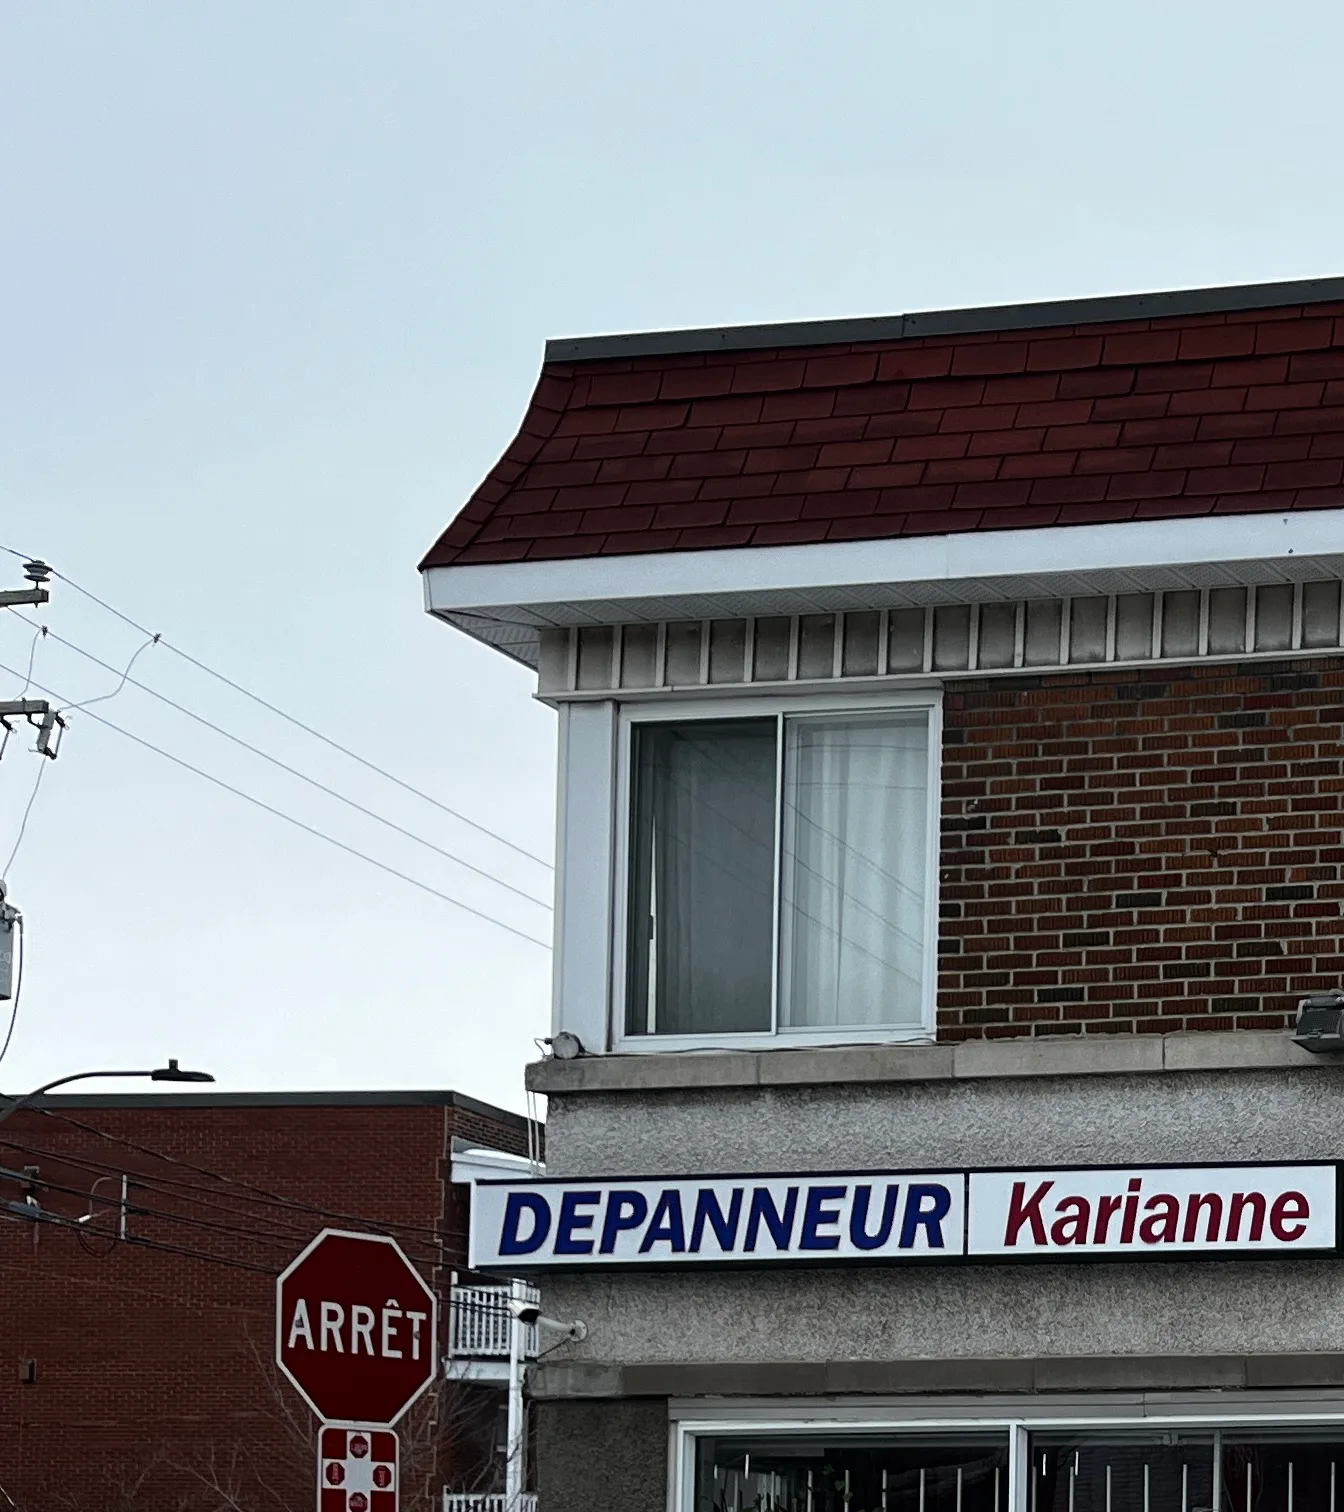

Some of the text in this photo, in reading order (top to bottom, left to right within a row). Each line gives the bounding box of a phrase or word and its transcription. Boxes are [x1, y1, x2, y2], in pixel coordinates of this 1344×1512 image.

[498, 1177, 1311, 1257] DEPANNEUR Karianne
[288, 1299, 428, 1361] ARRÊT
